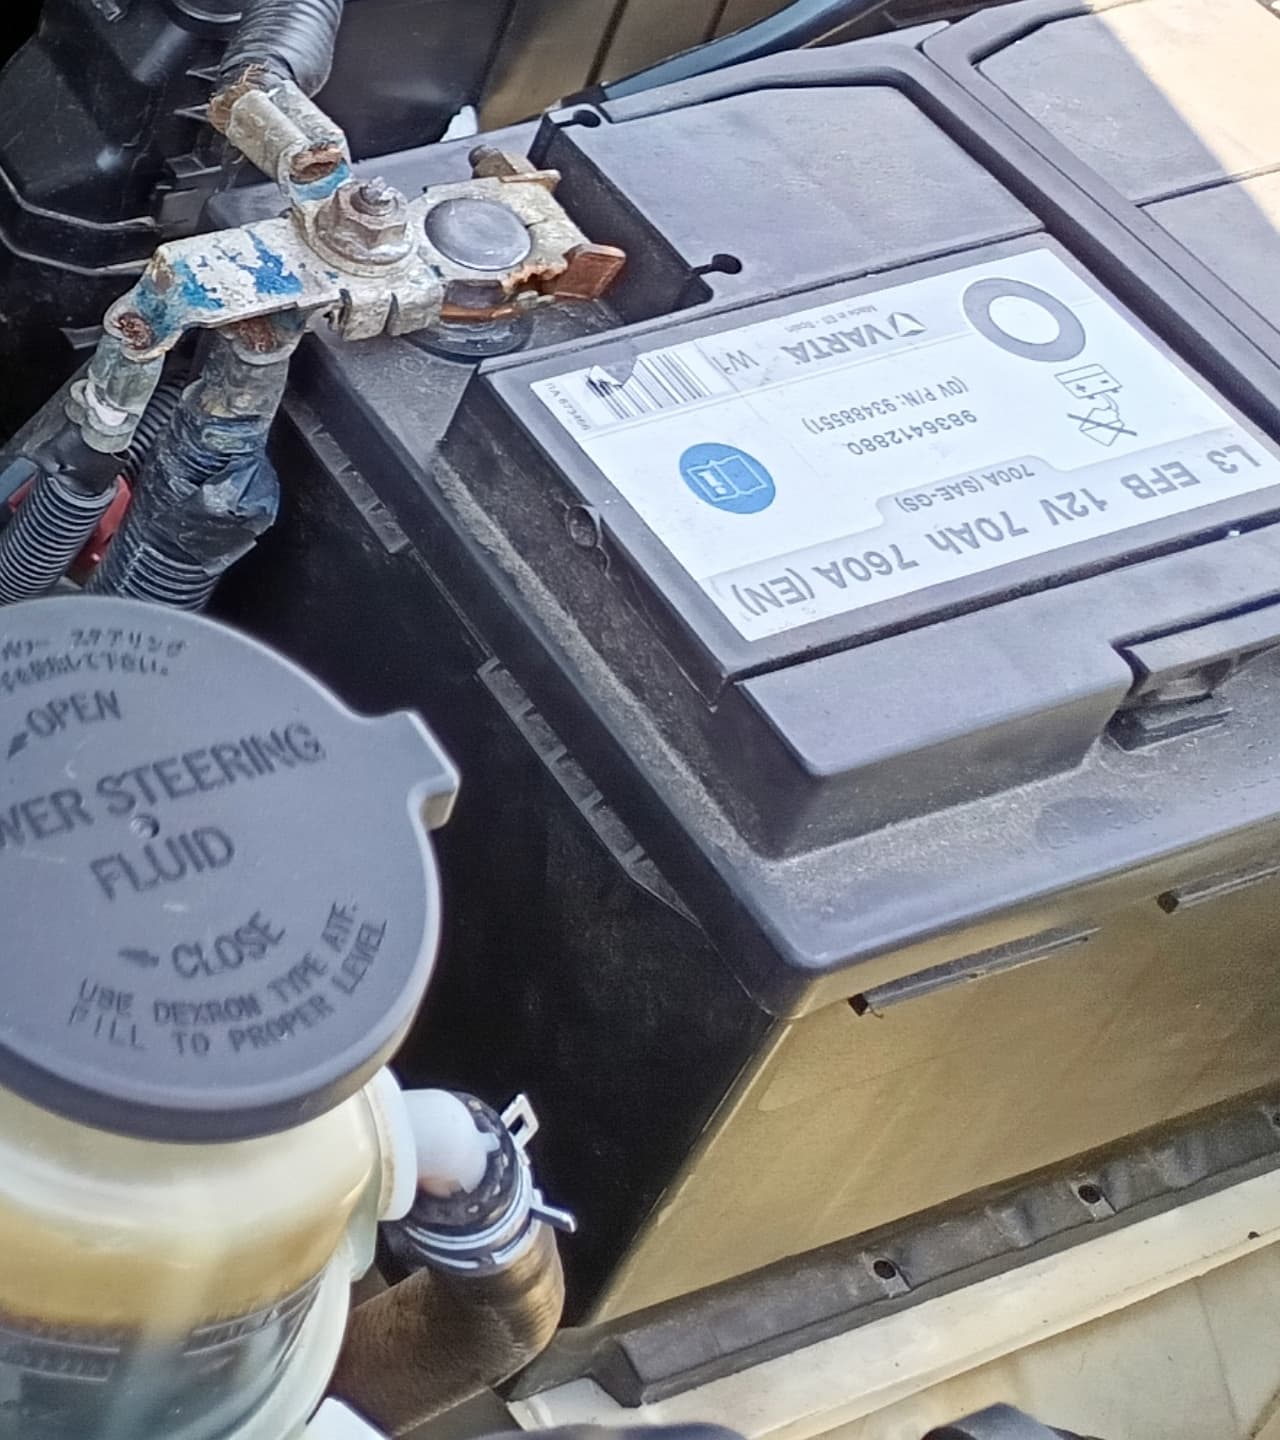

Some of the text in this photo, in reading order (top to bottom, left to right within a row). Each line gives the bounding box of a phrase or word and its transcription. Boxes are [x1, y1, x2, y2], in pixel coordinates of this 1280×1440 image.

[781, 324, 894, 364] VARTA
[846, 408, 978, 457] 9836412880
[895, 463, 1035, 513] 700A (SAE-GS)
[730, 443, 1262, 616] L3 EFB 12V 70Ah 760A (EN)
[28, 690, 122, 738] OPEN
[95, 724, 327, 816] STEERING
[90, 826, 235, 900] FLUID
[171, 911, 286, 980] CLOSE
[78, 977, 134, 1017] USE
[153, 992, 262, 1026] DEXRON
[269, 953, 329, 1015] TYPE
[174, 1029, 211, 1057] TO
[229, 993, 336, 1053] PROPER
[331, 918, 389, 996] LEVEL
